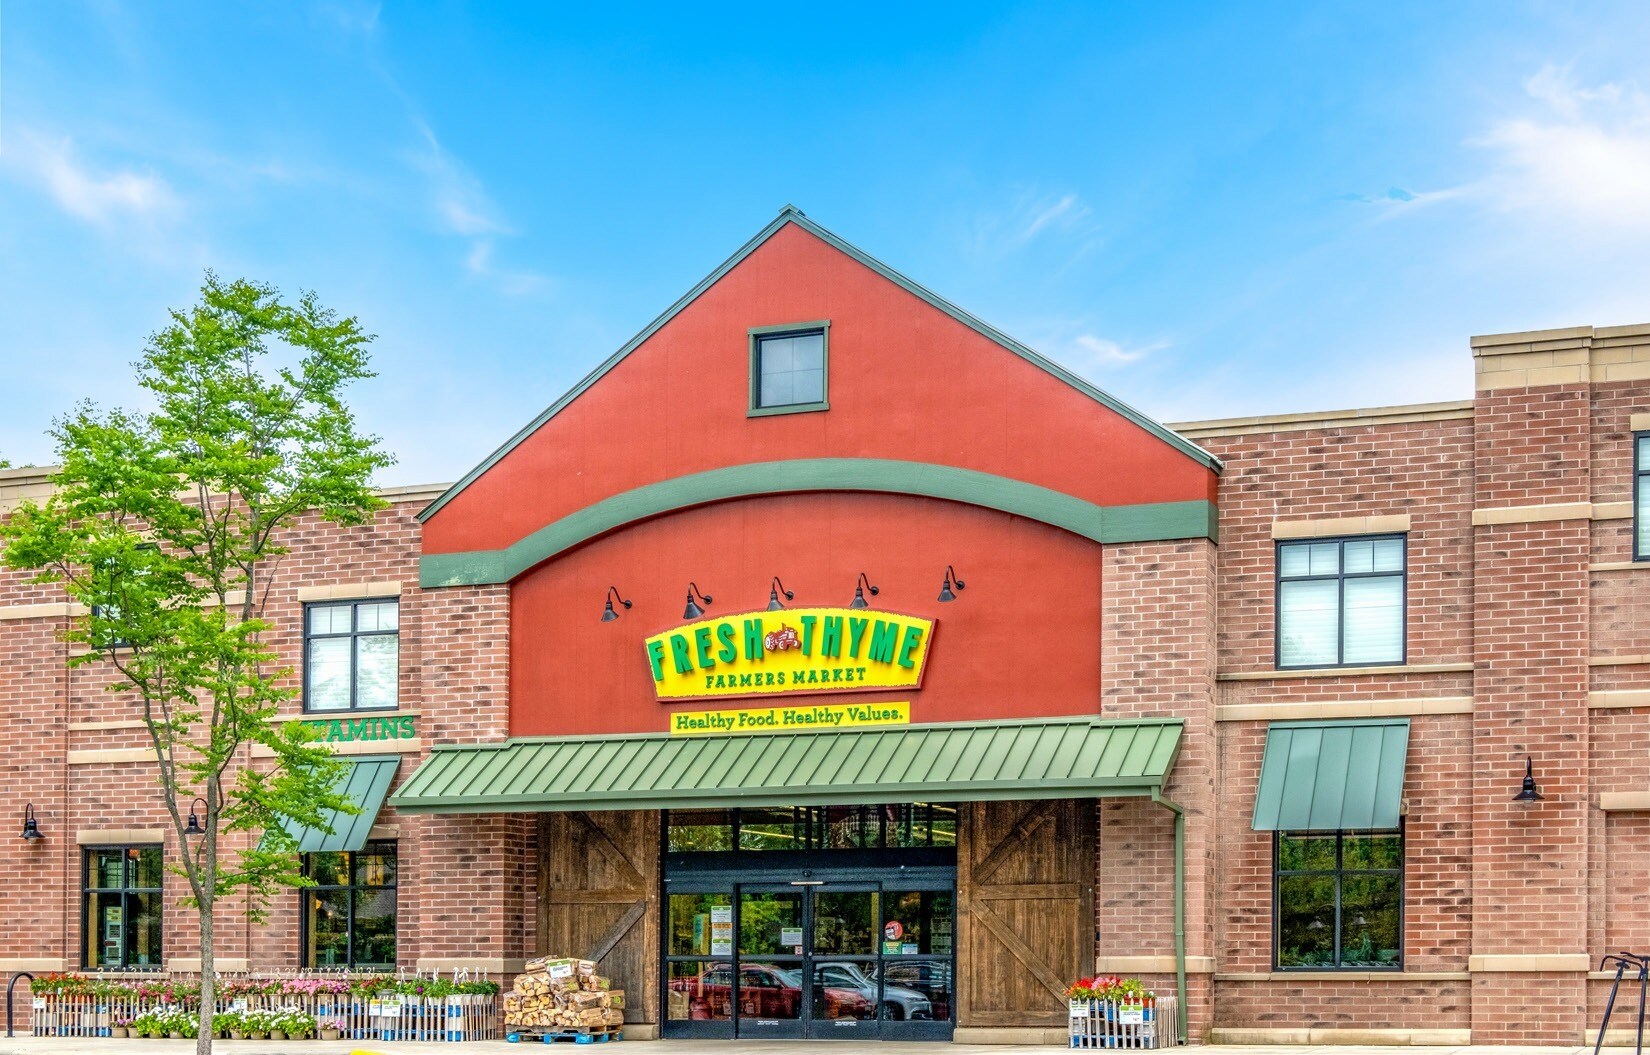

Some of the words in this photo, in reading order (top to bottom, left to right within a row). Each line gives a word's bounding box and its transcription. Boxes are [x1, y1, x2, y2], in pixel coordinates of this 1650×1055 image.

[648, 618, 764, 681] FRESH
[800, 616, 923, 669] THYME
[706, 672, 786, 689] FARMERS
[793, 667, 866, 684] MARKET
[301, 715, 416, 743] TAMINS
[676, 712, 735, 731] Healthy
[738, 711, 778, 727] Food.
[783, 708, 843, 725] Healthy
[847, 706, 903, 721] Values.
